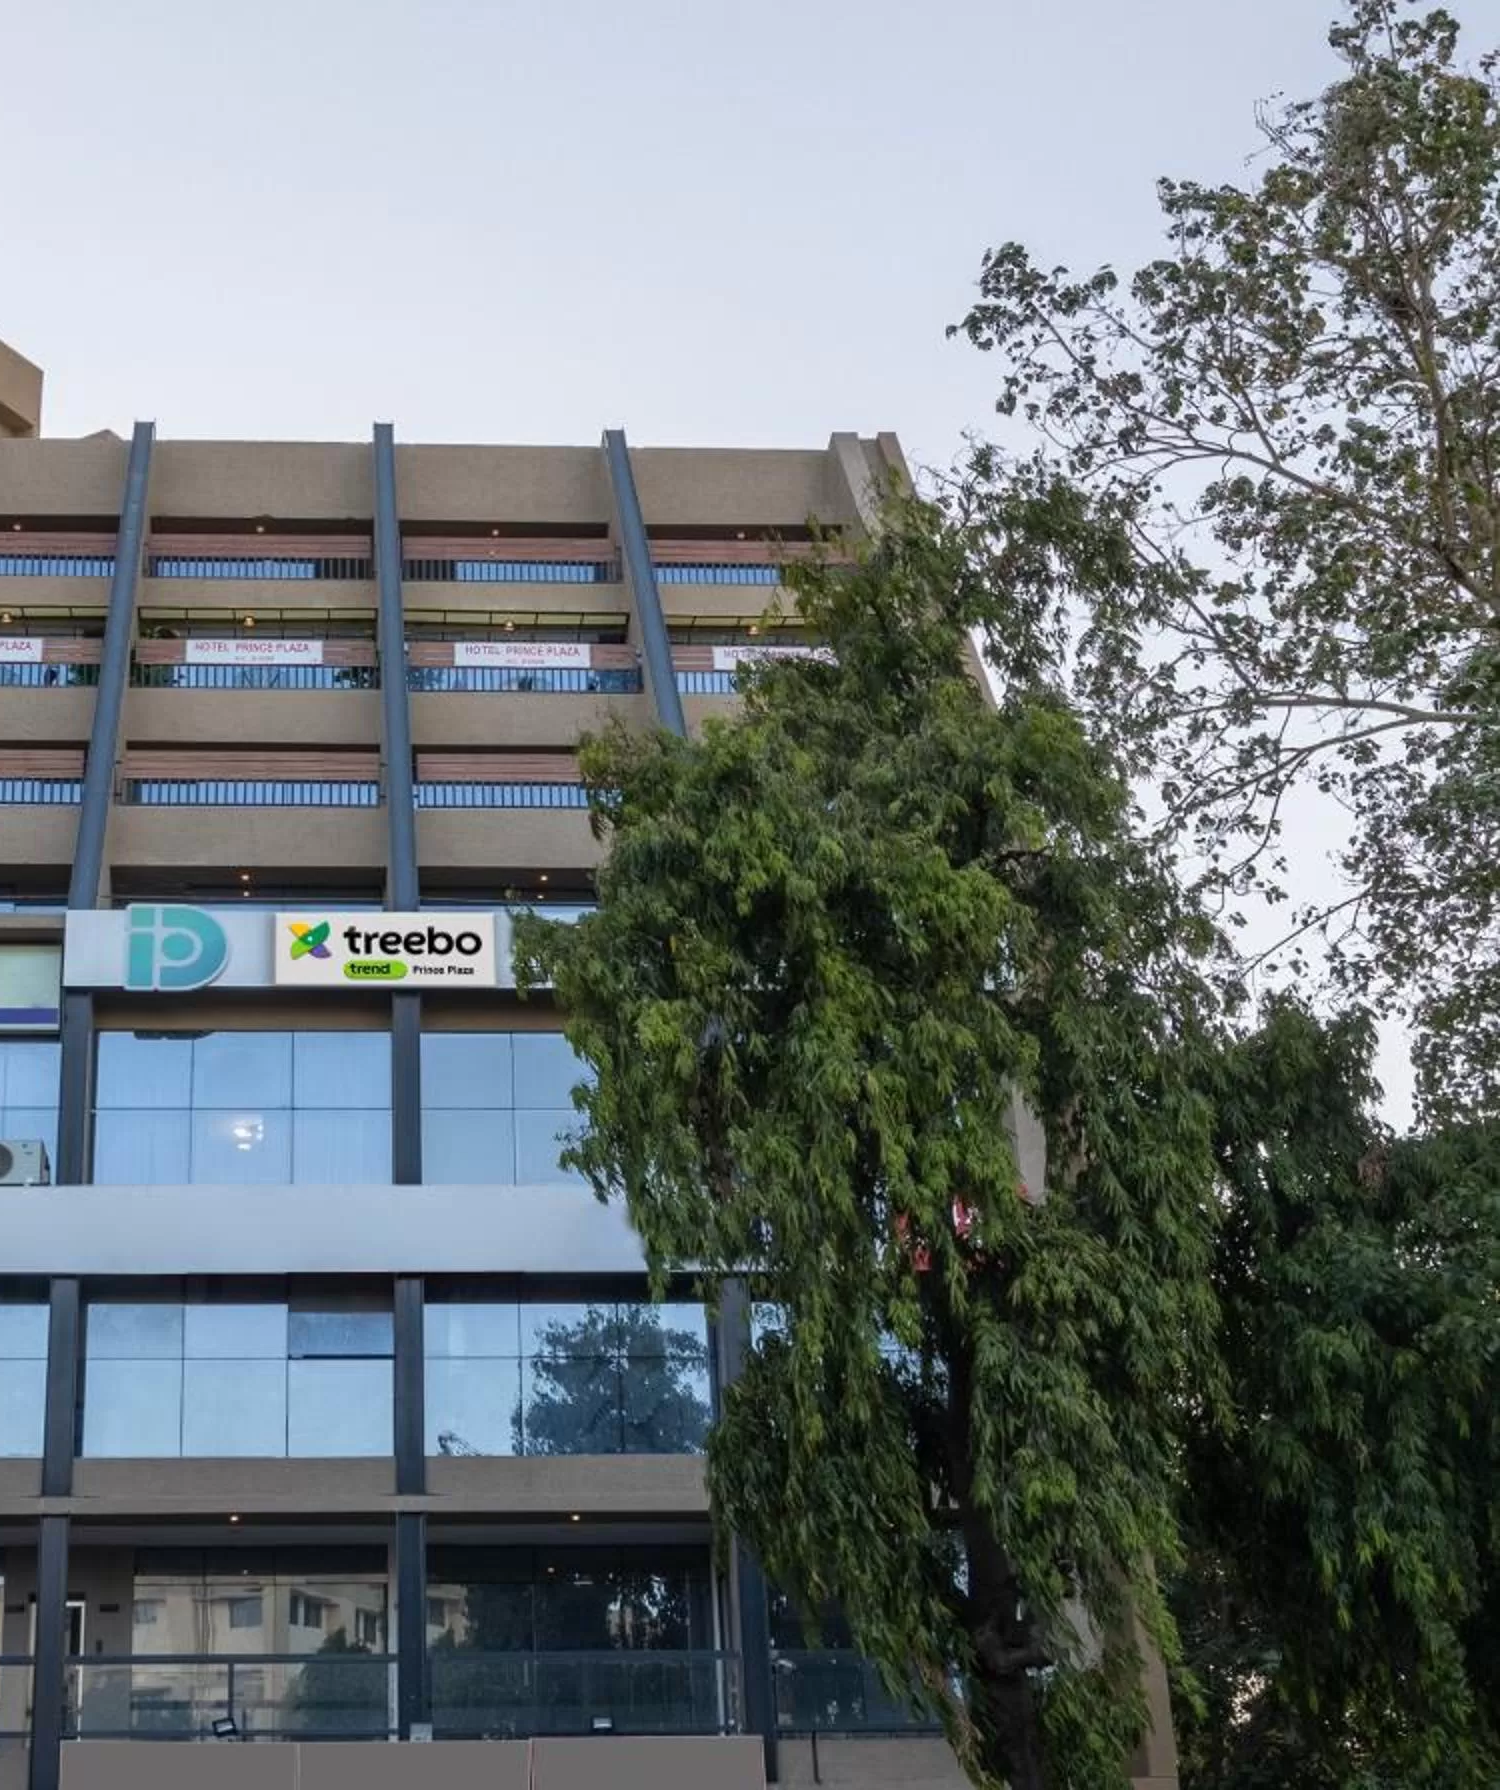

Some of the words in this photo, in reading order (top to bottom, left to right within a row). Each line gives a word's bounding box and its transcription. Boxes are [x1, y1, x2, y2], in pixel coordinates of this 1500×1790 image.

[195, 641, 230, 652] HOTEL
[235, 642, 273, 653] PRINCE
[275, 642, 310, 653] PLAZA
[465, 645, 500, 656] HOTEL
[506, 645, 545, 656] PRINCE
[547, 645, 581, 657] PLAZA
[343, 925, 483, 956] treebo
[350, 962, 391, 975] trend
[447, 965, 475, 975] Plaza
